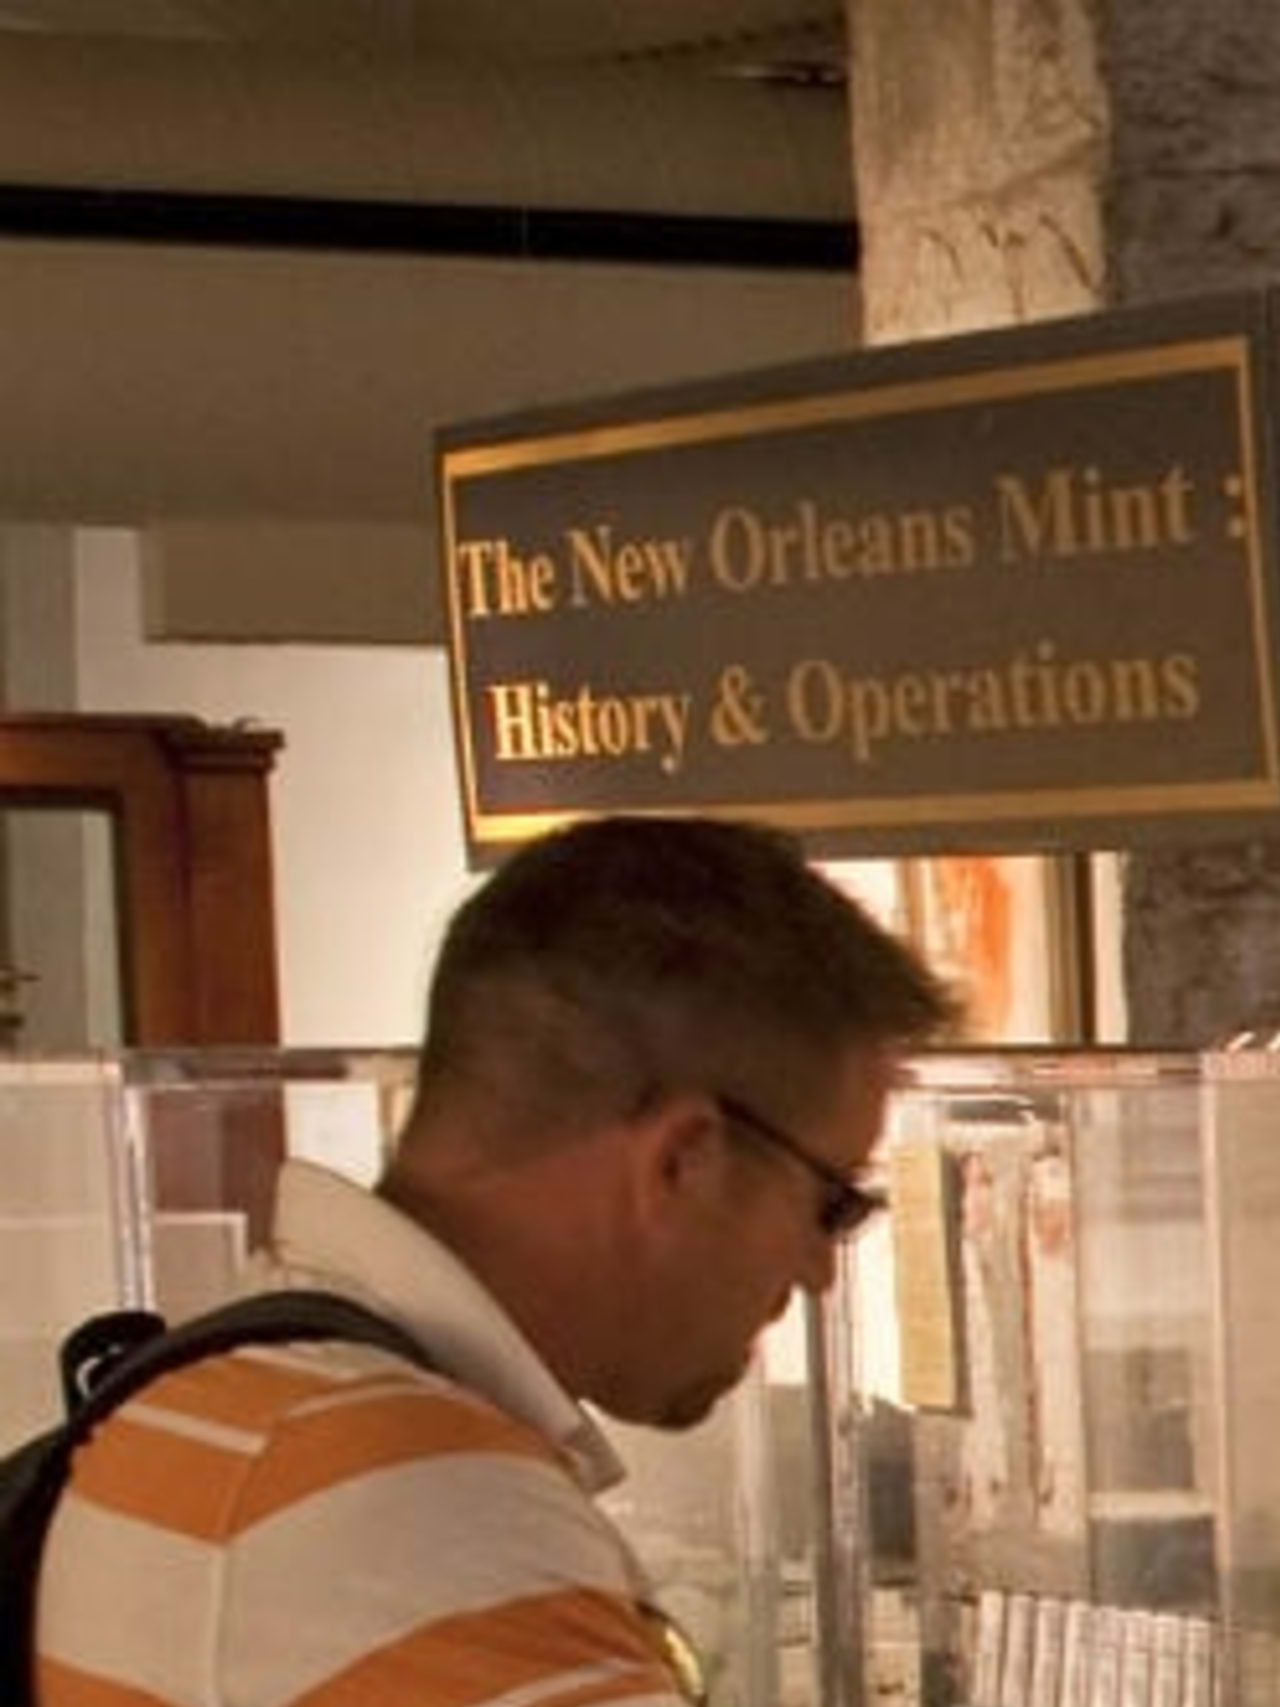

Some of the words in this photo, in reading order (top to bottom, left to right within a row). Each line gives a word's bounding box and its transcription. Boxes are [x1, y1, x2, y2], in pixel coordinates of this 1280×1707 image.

[458, 541, 555, 617] The
[568, 526, 691, 606] New
[710, 505, 976, 592] Orleans
[998, 466, 1197, 560] Mint
[490, 682, 691, 773] History
[711, 666, 767, 746] &
[789, 640, 1200, 763] Operations
